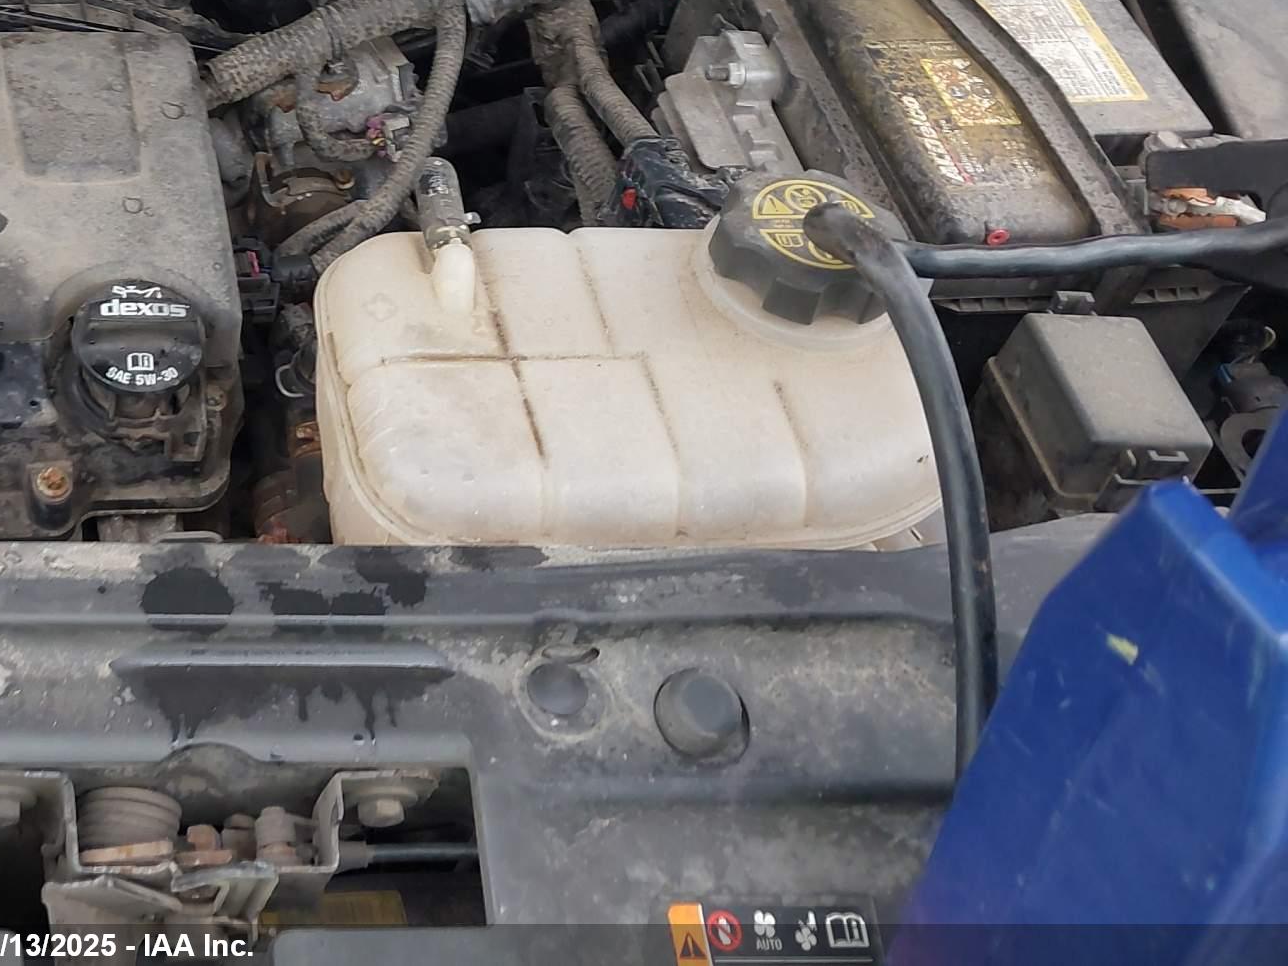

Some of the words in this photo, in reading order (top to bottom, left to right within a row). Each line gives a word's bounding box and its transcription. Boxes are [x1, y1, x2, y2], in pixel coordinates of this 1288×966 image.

[99, 298, 191, 318] dexos
[105, 366, 133, 385] SAE
[134, 366, 179, 386] 5W-30
[755, 937, 783, 952] AUTO
